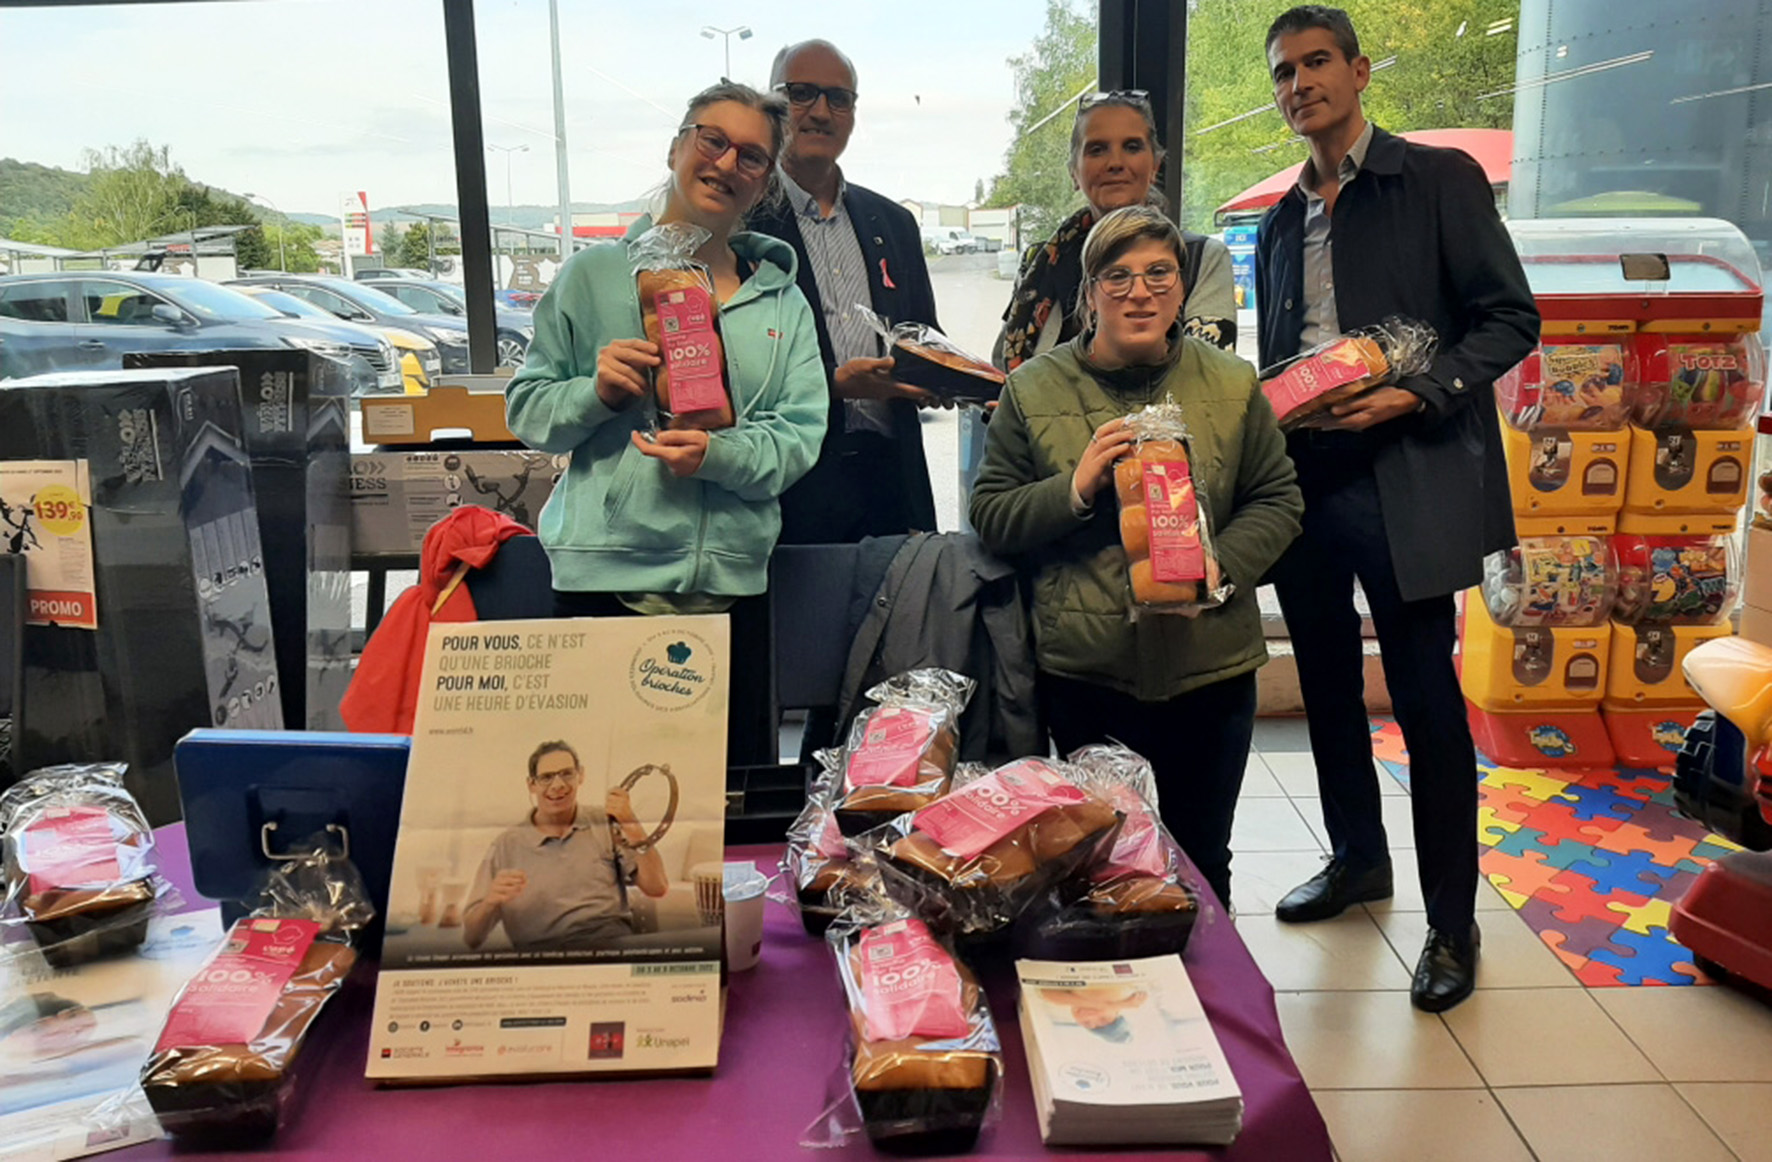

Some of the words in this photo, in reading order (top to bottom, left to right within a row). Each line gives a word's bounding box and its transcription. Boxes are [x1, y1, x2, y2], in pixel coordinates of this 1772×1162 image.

[668, 342, 711, 361] 100%
[1298, 364, 1320, 391] 100%
[1151, 514, 1190, 529] 100%
[30, 599, 82, 617] PROMO
[442, 635, 479, 651] POUR
[483, 635, 522, 651] VOUS,
[526, 634, 542, 649] CE
[547, 633, 587, 649] N'EST
[439, 655, 490, 671] QU'UNE
[493, 653, 553, 670] BRIOCHE
[436, 675, 474, 691] POUR
[478, 675, 508, 692] MOI,
[512, 673, 550, 689] C'EST
[433, 695, 463, 711] UNE
[465, 694, 511, 711] HEURE
[515, 692, 589, 710] D'ÉVASION
[197, 969, 277, 985] 100%
[873, 958, 942, 987] 100%
